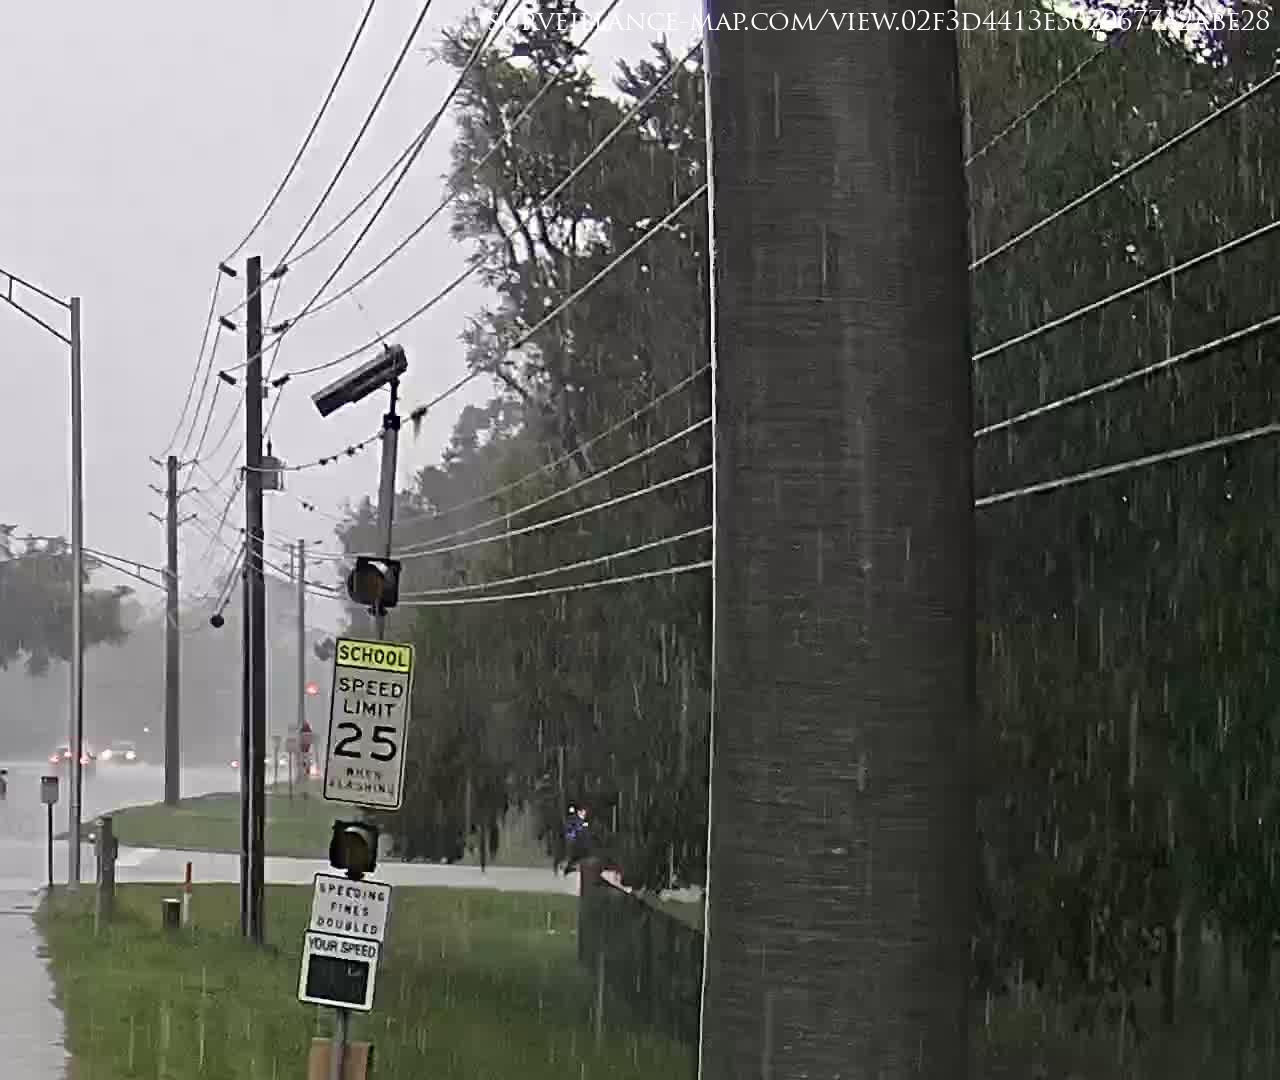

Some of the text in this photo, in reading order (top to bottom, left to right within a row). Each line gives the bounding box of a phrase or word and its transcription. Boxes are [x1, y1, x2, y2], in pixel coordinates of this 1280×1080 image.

[339, 644, 409, 667] SCHOOL
[339, 677, 403, 698] SPEED
[343, 698, 396, 718] LIMIT
[334, 722, 397, 761] 25
[319, 882, 385, 902] SPEEDING
[330, 901, 369, 917] FINES
[316, 916, 378, 935] DOUBLED
[309, 936, 377, 958] YOUR SPEED
